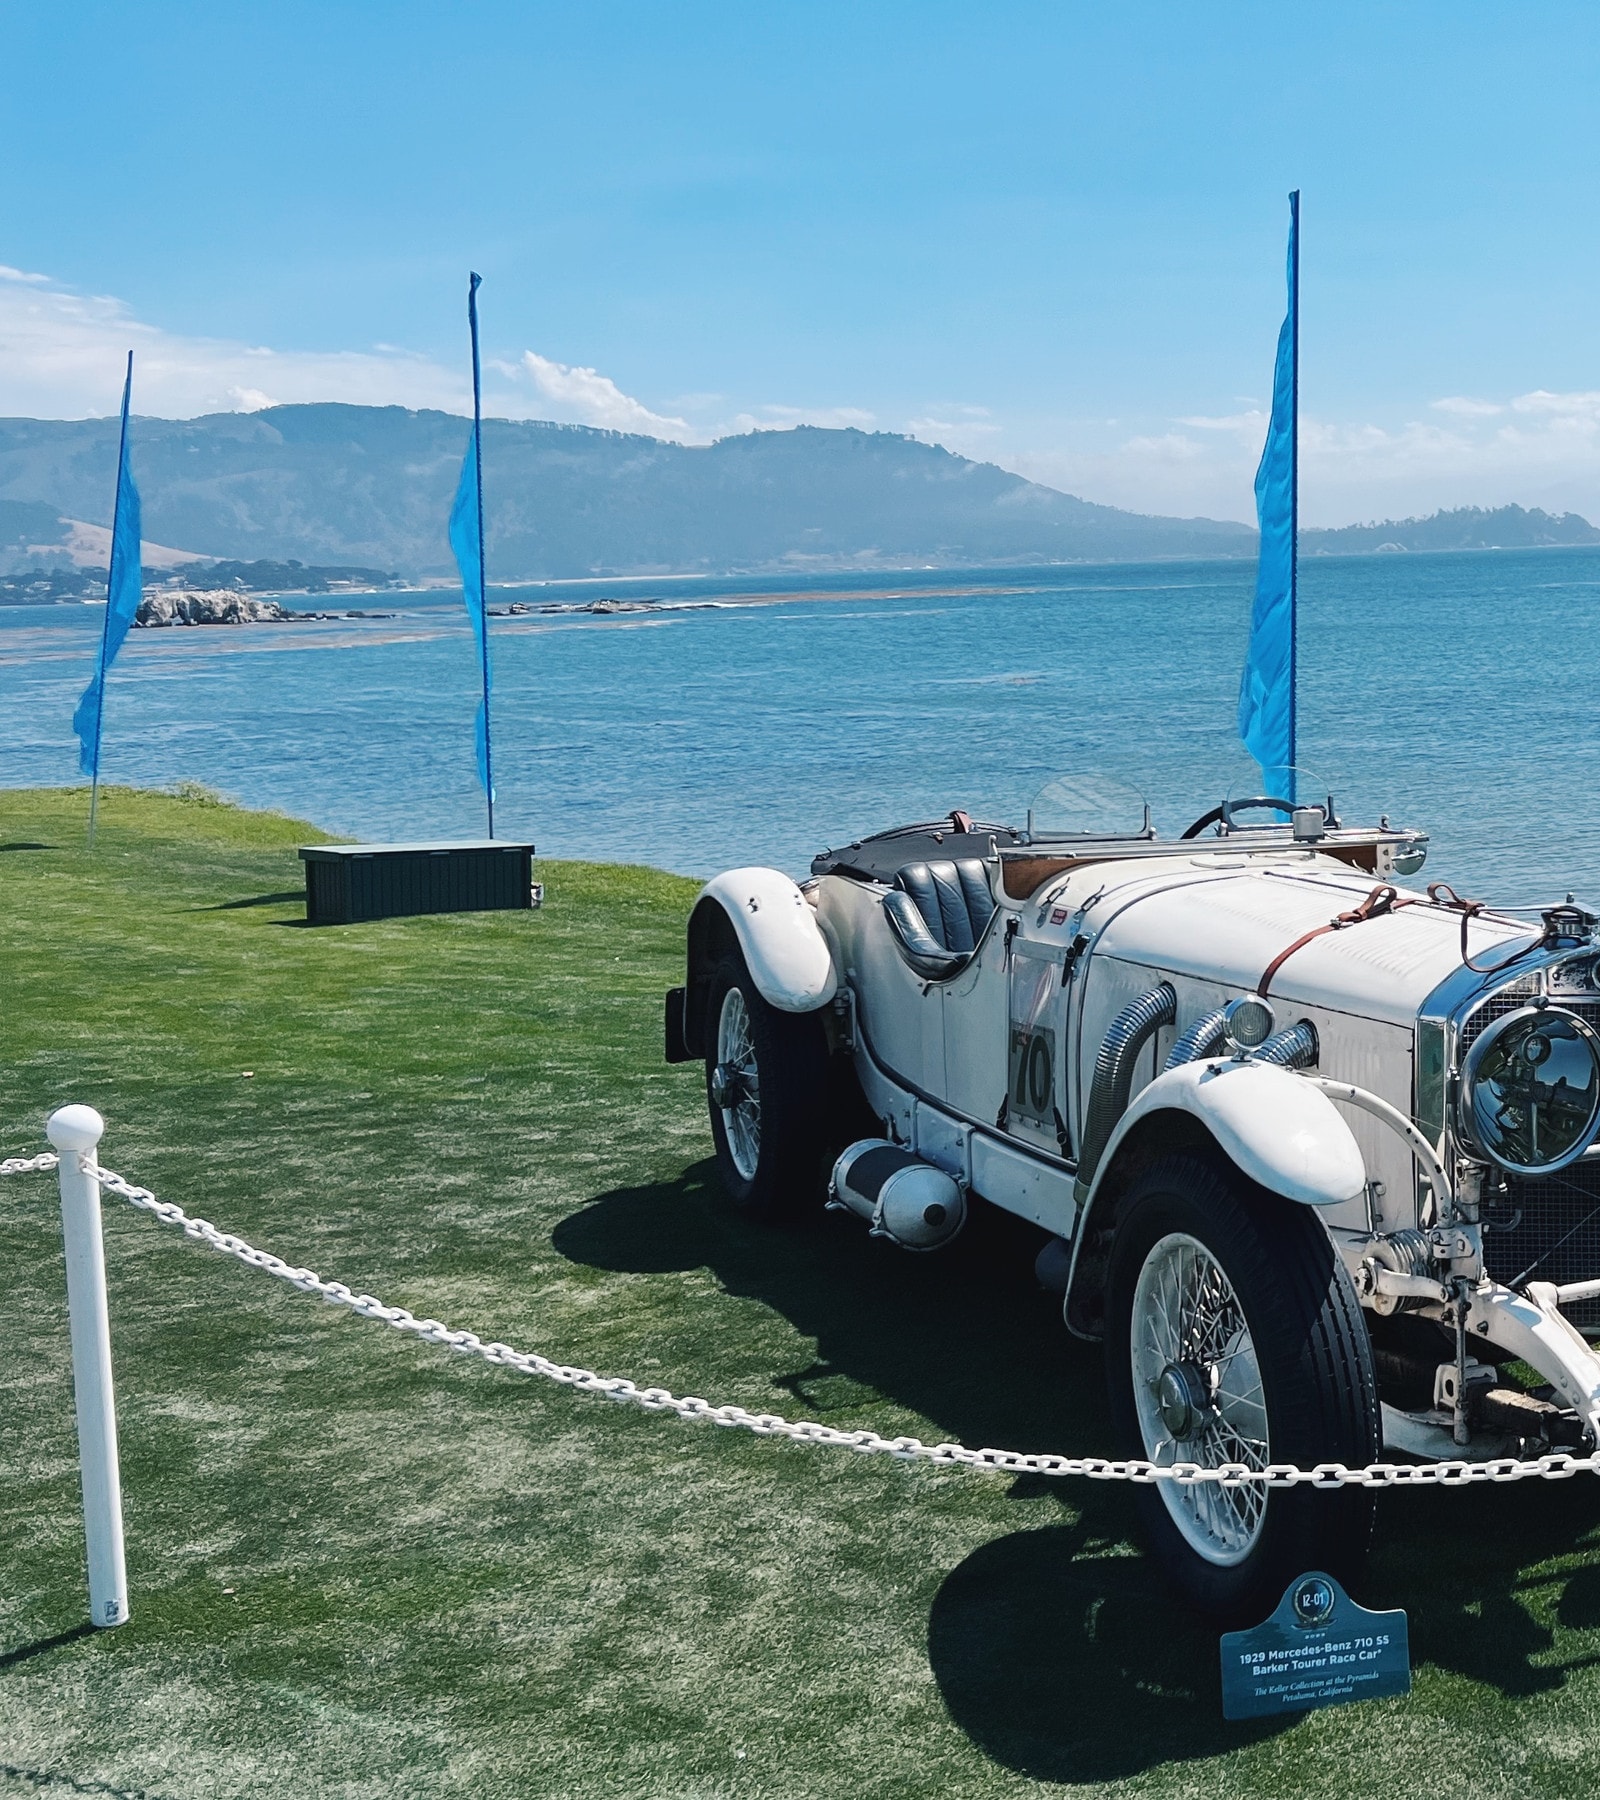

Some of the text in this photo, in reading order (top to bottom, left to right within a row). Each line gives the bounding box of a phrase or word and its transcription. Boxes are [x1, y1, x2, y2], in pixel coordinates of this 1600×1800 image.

[1012, 1029, 1051, 1114] 70
[1303, 1593, 1324, 1607] 12-01
[1240, 1635, 1389, 1665] 1929 Mercedes-Benz 710 SS
[1253, 1663, 1289, 1676] Barker
[1292, 1658, 1327, 1670] Tourer
[1330, 1653, 1356, 1665] Race
[1255, 1687, 1267, 1697] The
[1290, 1680, 1325, 1691] Collection
[1334, 1676, 1345, 1685] the
[1347, 1671, 1379, 1684] Pyramids
[1318, 1686, 1353, 1697] California
